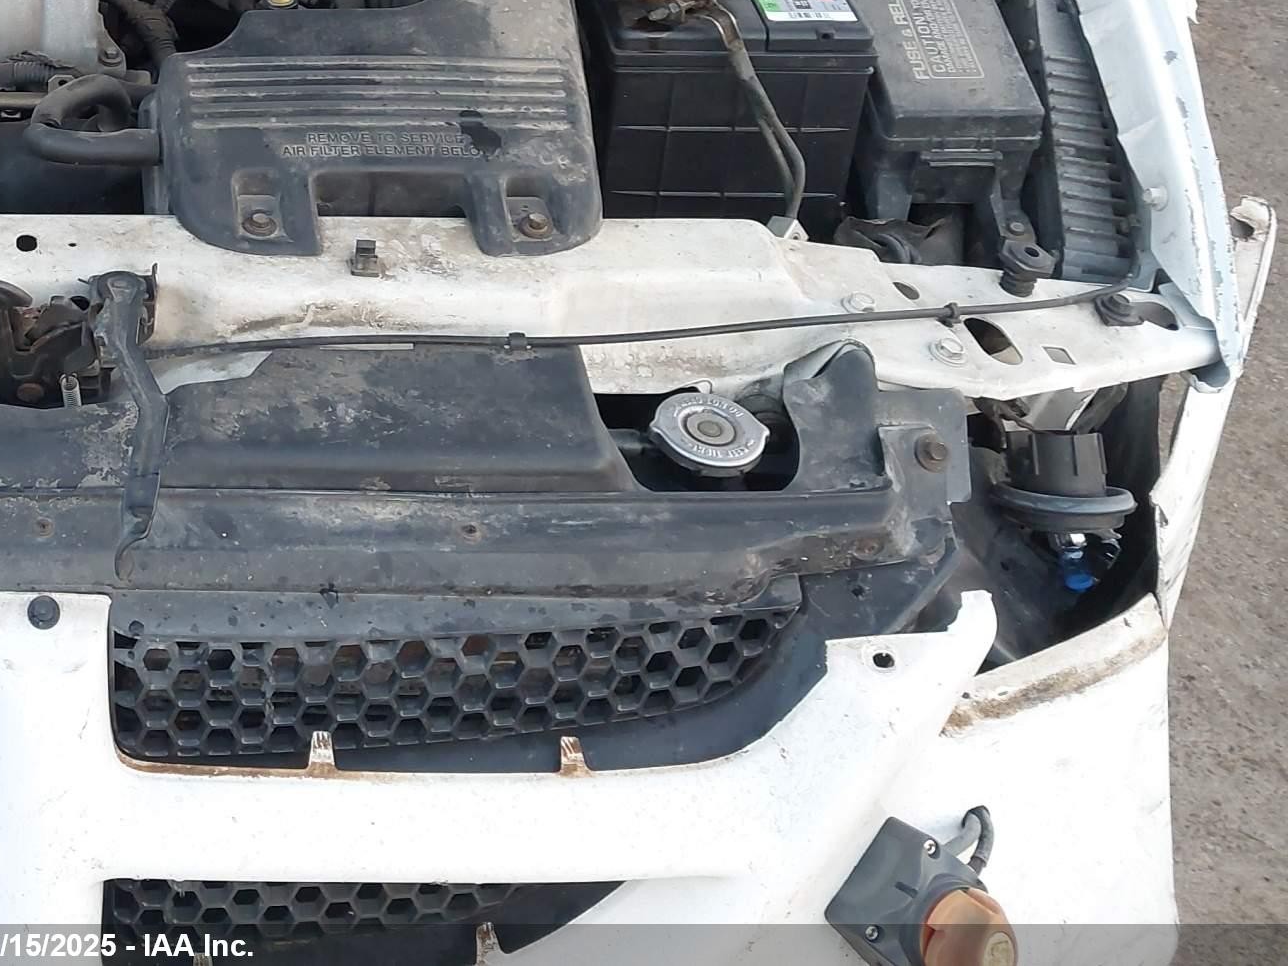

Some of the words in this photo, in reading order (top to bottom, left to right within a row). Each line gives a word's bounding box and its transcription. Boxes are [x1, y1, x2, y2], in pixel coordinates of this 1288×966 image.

[913, 12, 946, 73] CAUTION!
[902, 40, 930, 79] FUSE
[282, 145, 305, 156] AIR
[310, 145, 361, 156] FILTER
[365, 145, 434, 156] ELEMENT
[440, 145, 484, 156] BELO
[307, 133, 370, 144] REMOVE
[377, 133, 396, 144] TO
[400, 133, 464, 144] SERVICE
